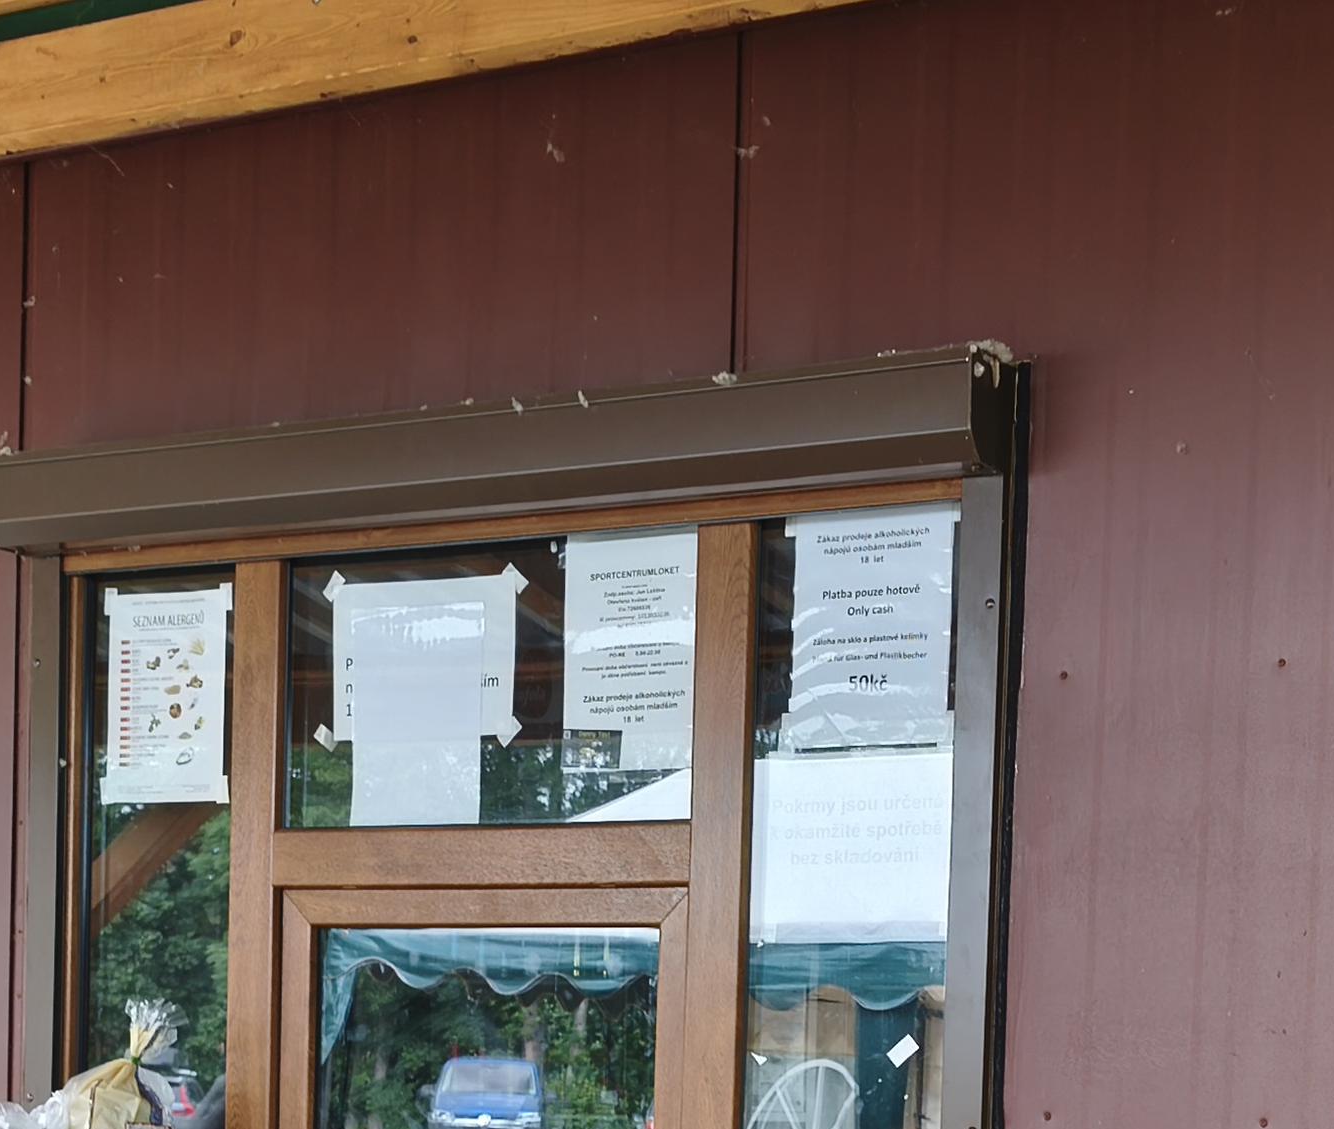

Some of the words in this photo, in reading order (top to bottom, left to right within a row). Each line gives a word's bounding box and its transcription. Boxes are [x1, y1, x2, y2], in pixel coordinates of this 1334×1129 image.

[817, 534, 840, 544] Zákaz
[842, 532, 873, 543] prodeje
[874, 527, 930, 539] alkoholických
[823, 545, 851, 556] nápojů
[853, 543, 886, 553] osobám
[887, 540, 922, 550] mladším
[860, 555, 870, 564] 18
[873, 555, 884, 563] let
[822, 587, 852, 600] Platba
[855, 588, 883, 600] pouze
[886, 584, 921, 596] hotově
[847, 605, 870, 617] Only
[872, 603, 894, 614] cash
[133, 614, 166, 629] SEZNAM
[167, 610, 206, 628] ALERGENŮ
[813, 637, 836, 646] Záloha
[848, 635, 862, 644] sklo
[869, 634, 899, 644] plastové
[900, 631, 928, 641] kelímky
[865, 651, 878, 660] und
[849, 674, 888, 693] 50kč
[582, 695, 605, 703] Zákaz
[606, 692, 633, 703] prodeje
[635, 689, 686, 700] alkoholických
[589, 705, 615, 715] nápojů
[616, 703, 645, 713] osobám
[647, 701, 678, 711] mladším
[772, 799, 837, 818] Pokrmy
[841, 798, 878, 816] jsou
[791, 850, 819, 866] bez
[824, 847, 920, 865] skladování
